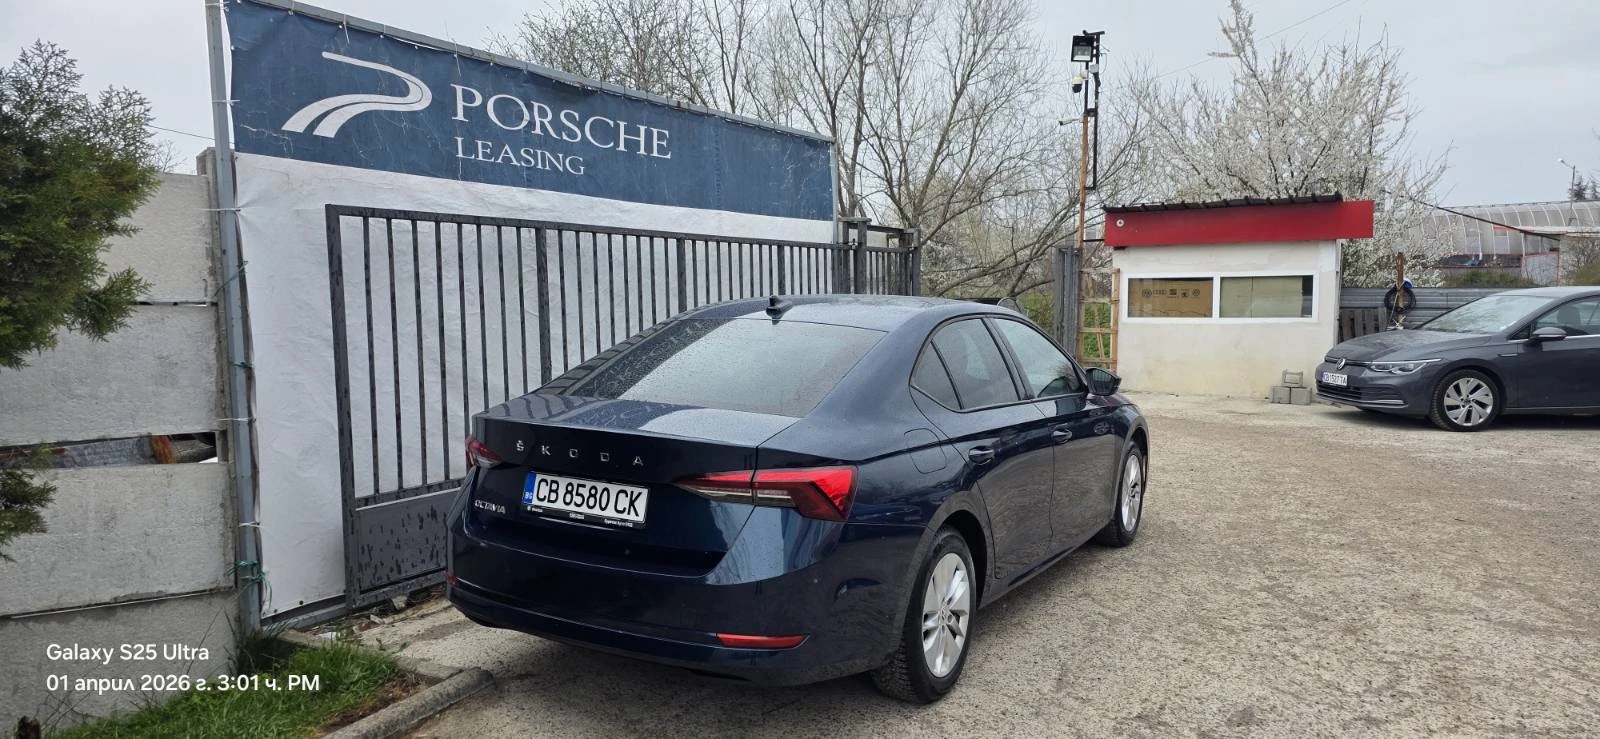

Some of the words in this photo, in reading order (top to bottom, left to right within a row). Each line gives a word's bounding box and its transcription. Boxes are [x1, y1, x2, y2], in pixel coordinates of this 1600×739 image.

[450, 83, 672, 159] PORSCHE
[454, 136, 585, 175] LEASING
[474, 499, 506, 515] OCTAVIA
[536, 478, 559, 504] CB
[562, 482, 610, 511] 8580
[614, 489, 644, 517] CK
